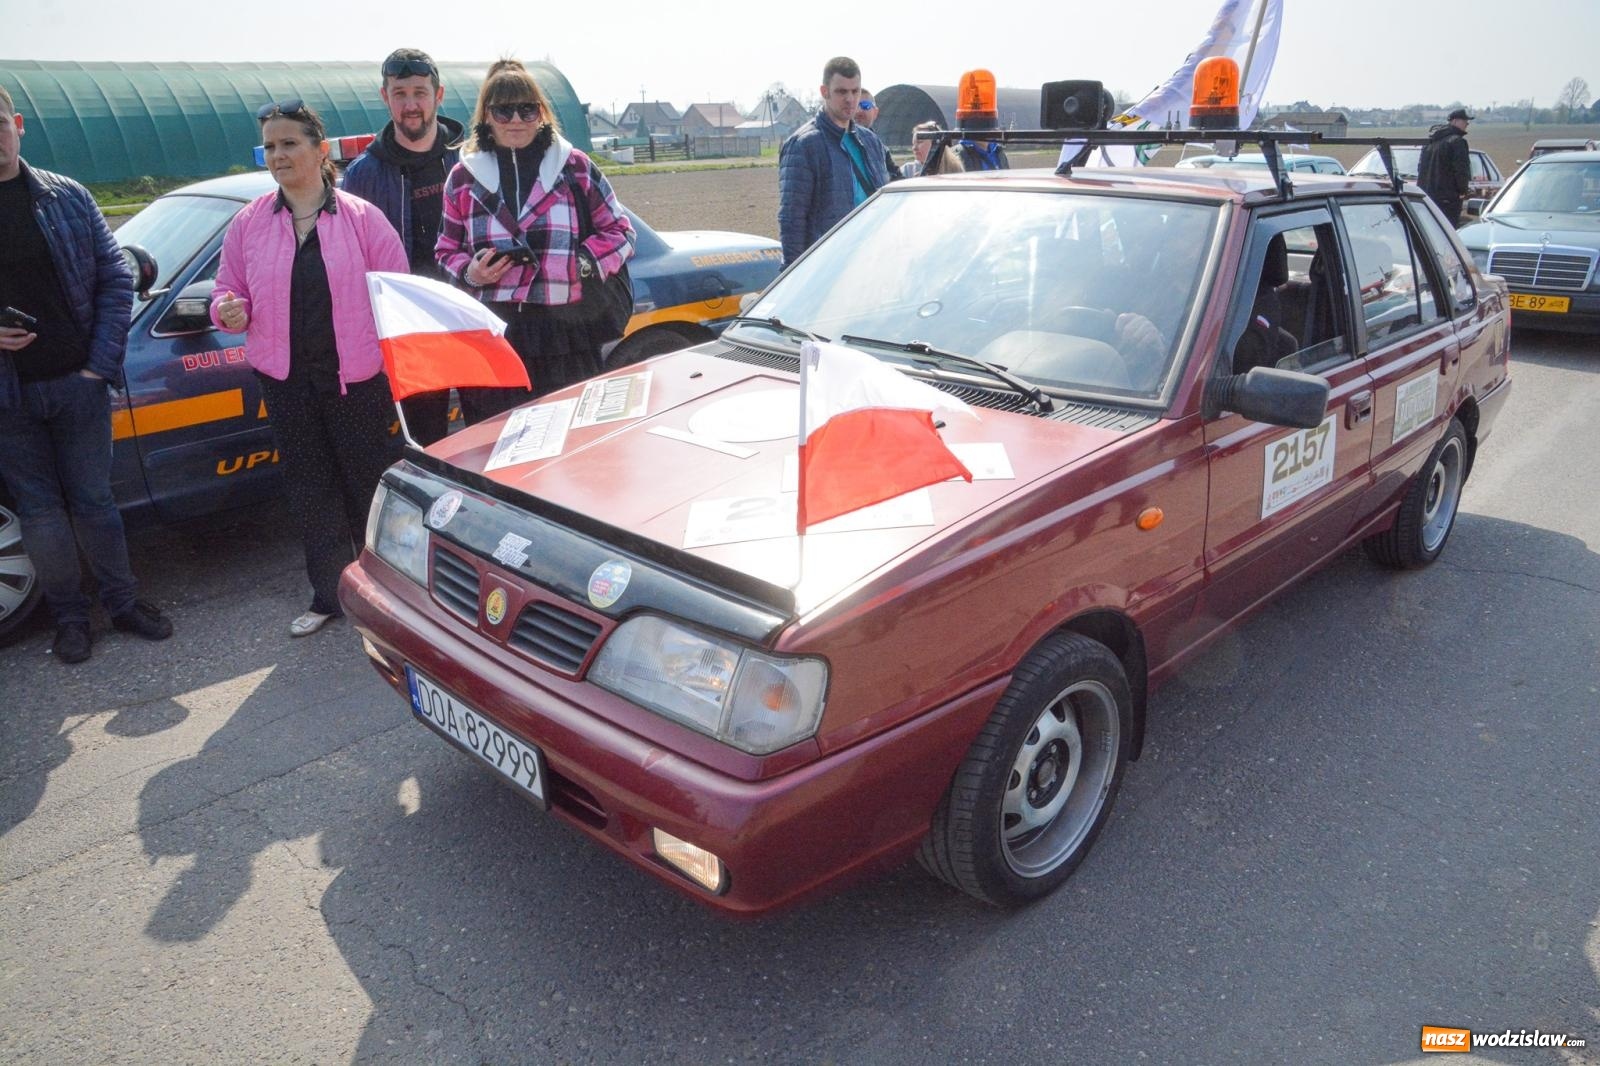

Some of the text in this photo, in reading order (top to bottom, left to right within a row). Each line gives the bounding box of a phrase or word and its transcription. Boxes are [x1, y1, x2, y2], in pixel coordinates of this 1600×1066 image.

[1529, 296, 1546, 309] 89
[182, 350, 221, 372] DUI
[1271, 422, 1331, 485] 2157
[417, 679, 537, 790] DOA 82999
